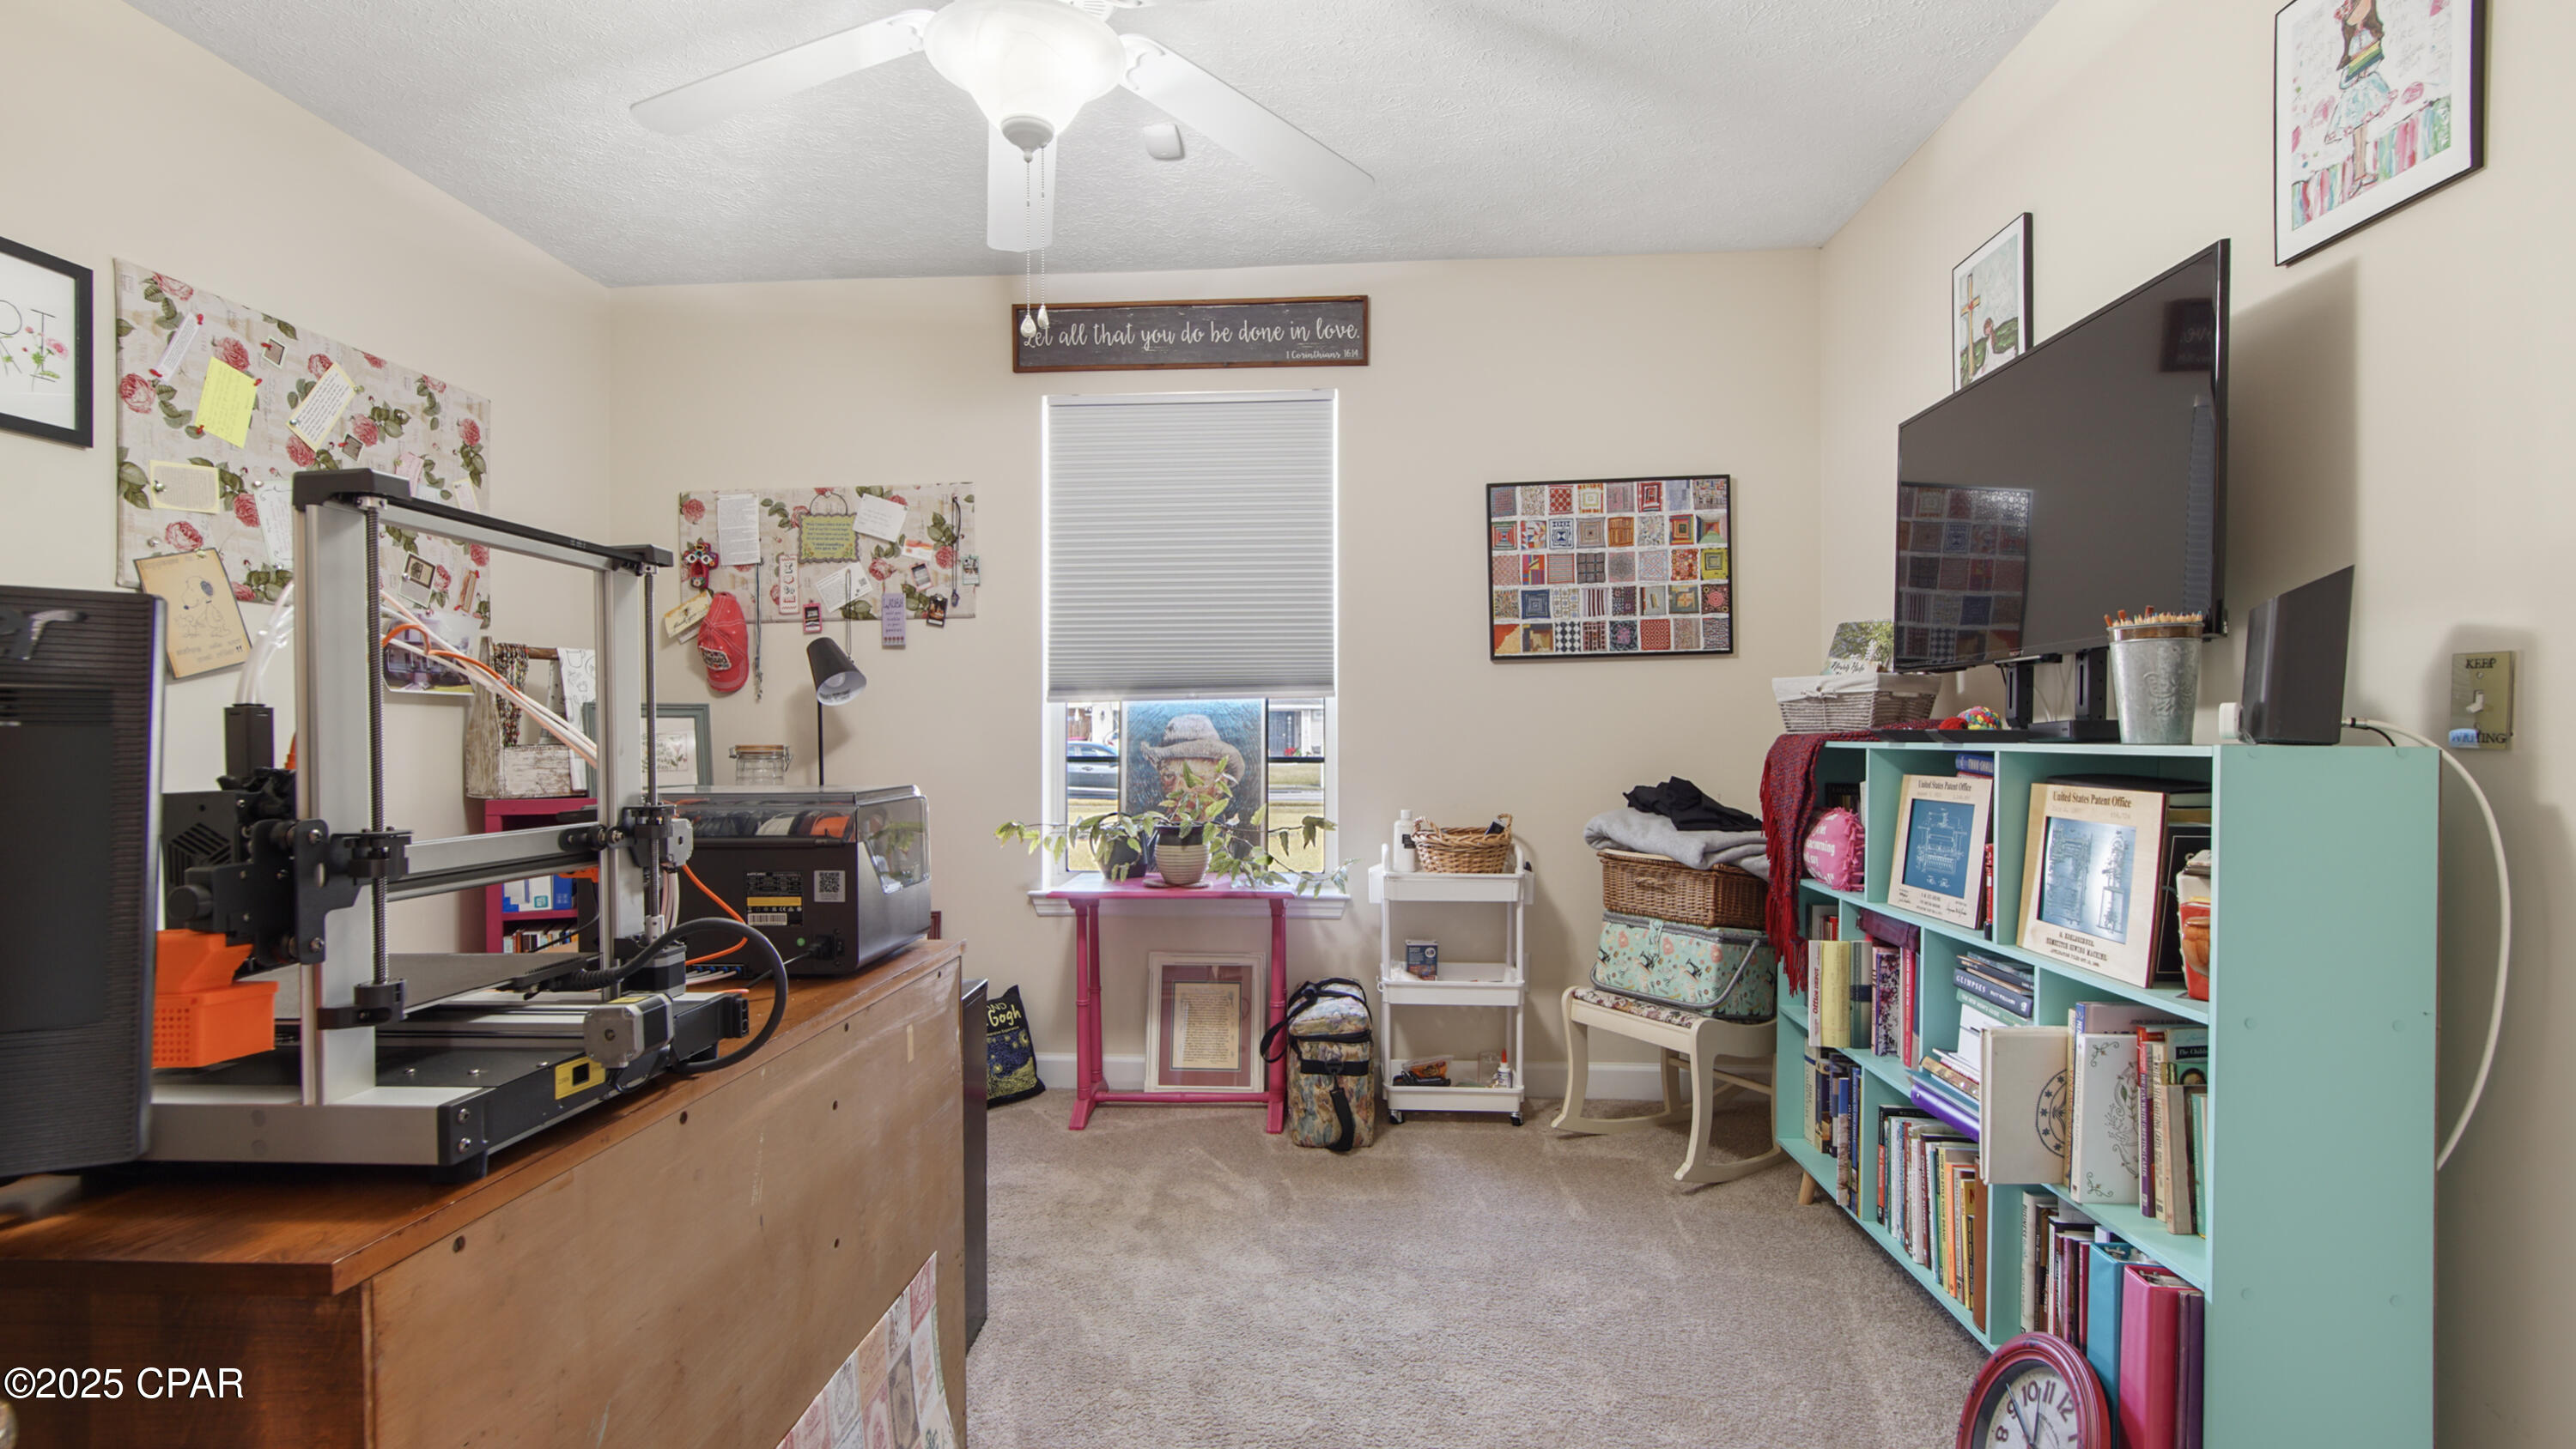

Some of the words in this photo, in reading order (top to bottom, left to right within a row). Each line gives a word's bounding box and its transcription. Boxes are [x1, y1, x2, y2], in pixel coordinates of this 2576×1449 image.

[1059, 323, 1088, 346] all
[1094, 322, 1135, 346] that
[1141, 328, 1176, 351] you
[1182, 321, 1205, 344] do
[1211, 320, 1233, 343] be
[1238, 319, 1285, 343] done
[1291, 320, 1311, 342] in
[1316, 317, 1360, 339] love.
[1291, 349, 1341, 359] Corinthians
[2466, 658, 2497, 670] KEEP
[1918, 780, 1931, 789] United
[1932, 781, 1944, 790] States
[1944, 781, 1958, 791] Patent
[1958, 783, 1972, 791] Office
[2053, 791, 2071, 802] United
[2072, 792, 2090, 804] States
[2090, 794, 2111, 805] Patent
[2111, 796, 2132, 808] Office
[1956, 975, 1986, 993] GLIMPSES
[987, 1003, 1022, 1027] Gogh
[1941, 1171, 1945, 1179] TO
[2021, 1379, 2039, 1407] 10
[2042, 1379, 2057, 1404] 11
[2057, 1391, 2075, 1422] 12
[1995, 1424, 2009, 1443] 8
